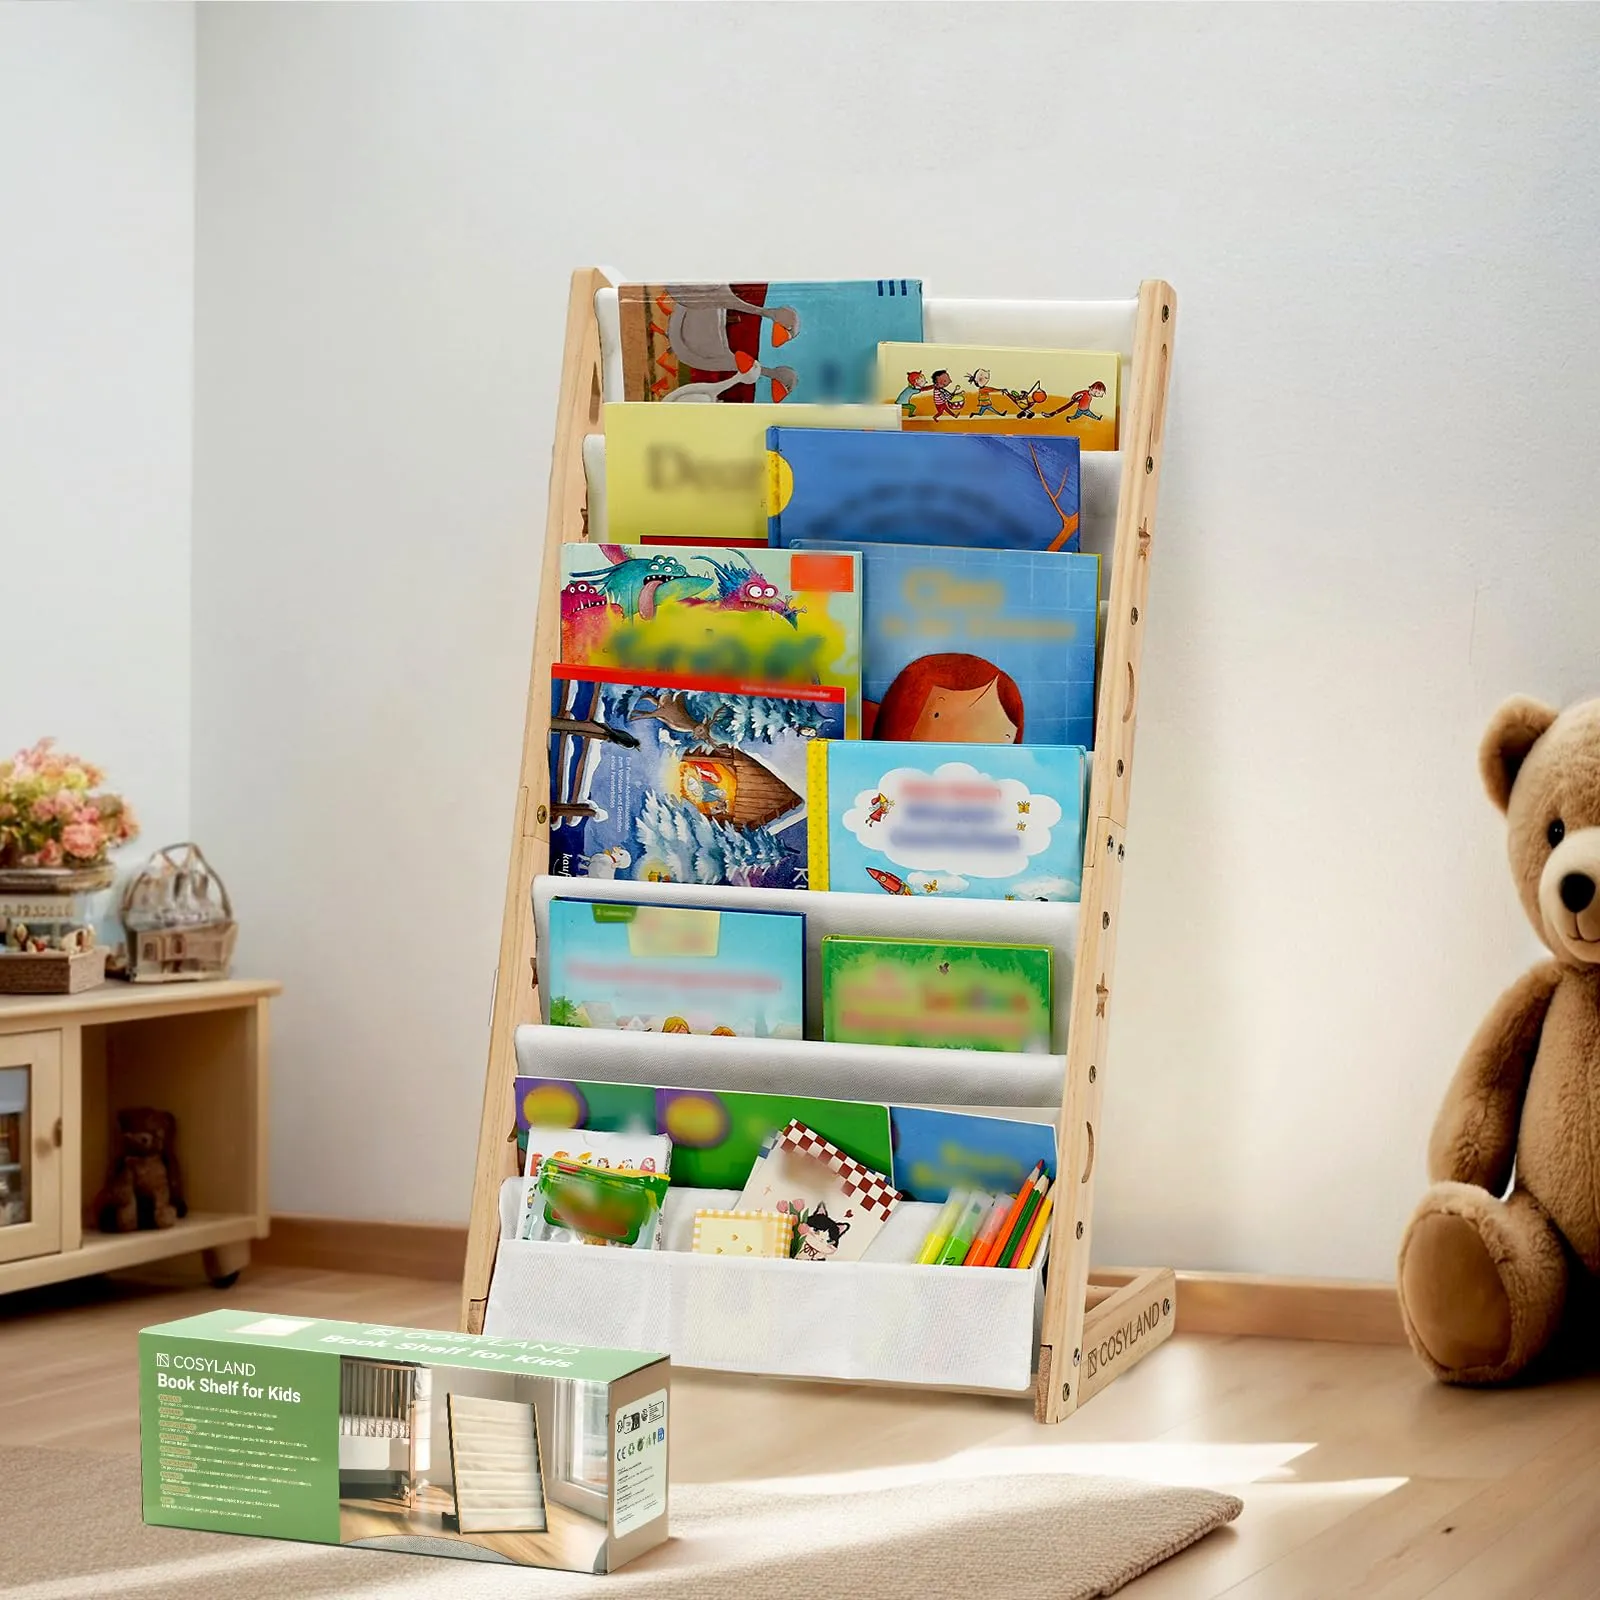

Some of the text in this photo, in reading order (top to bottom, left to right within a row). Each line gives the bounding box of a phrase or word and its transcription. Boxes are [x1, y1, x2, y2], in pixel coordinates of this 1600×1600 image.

[403, 1332, 581, 1355] COSYLAND
[1100, 1302, 1160, 1367] COSYLAND
[173, 1355, 256, 1377] COSYLAND
[318, 1334, 575, 1369] Book Shelf for Kids
[157, 1372, 301, 1404] Book Shelf for Kids
